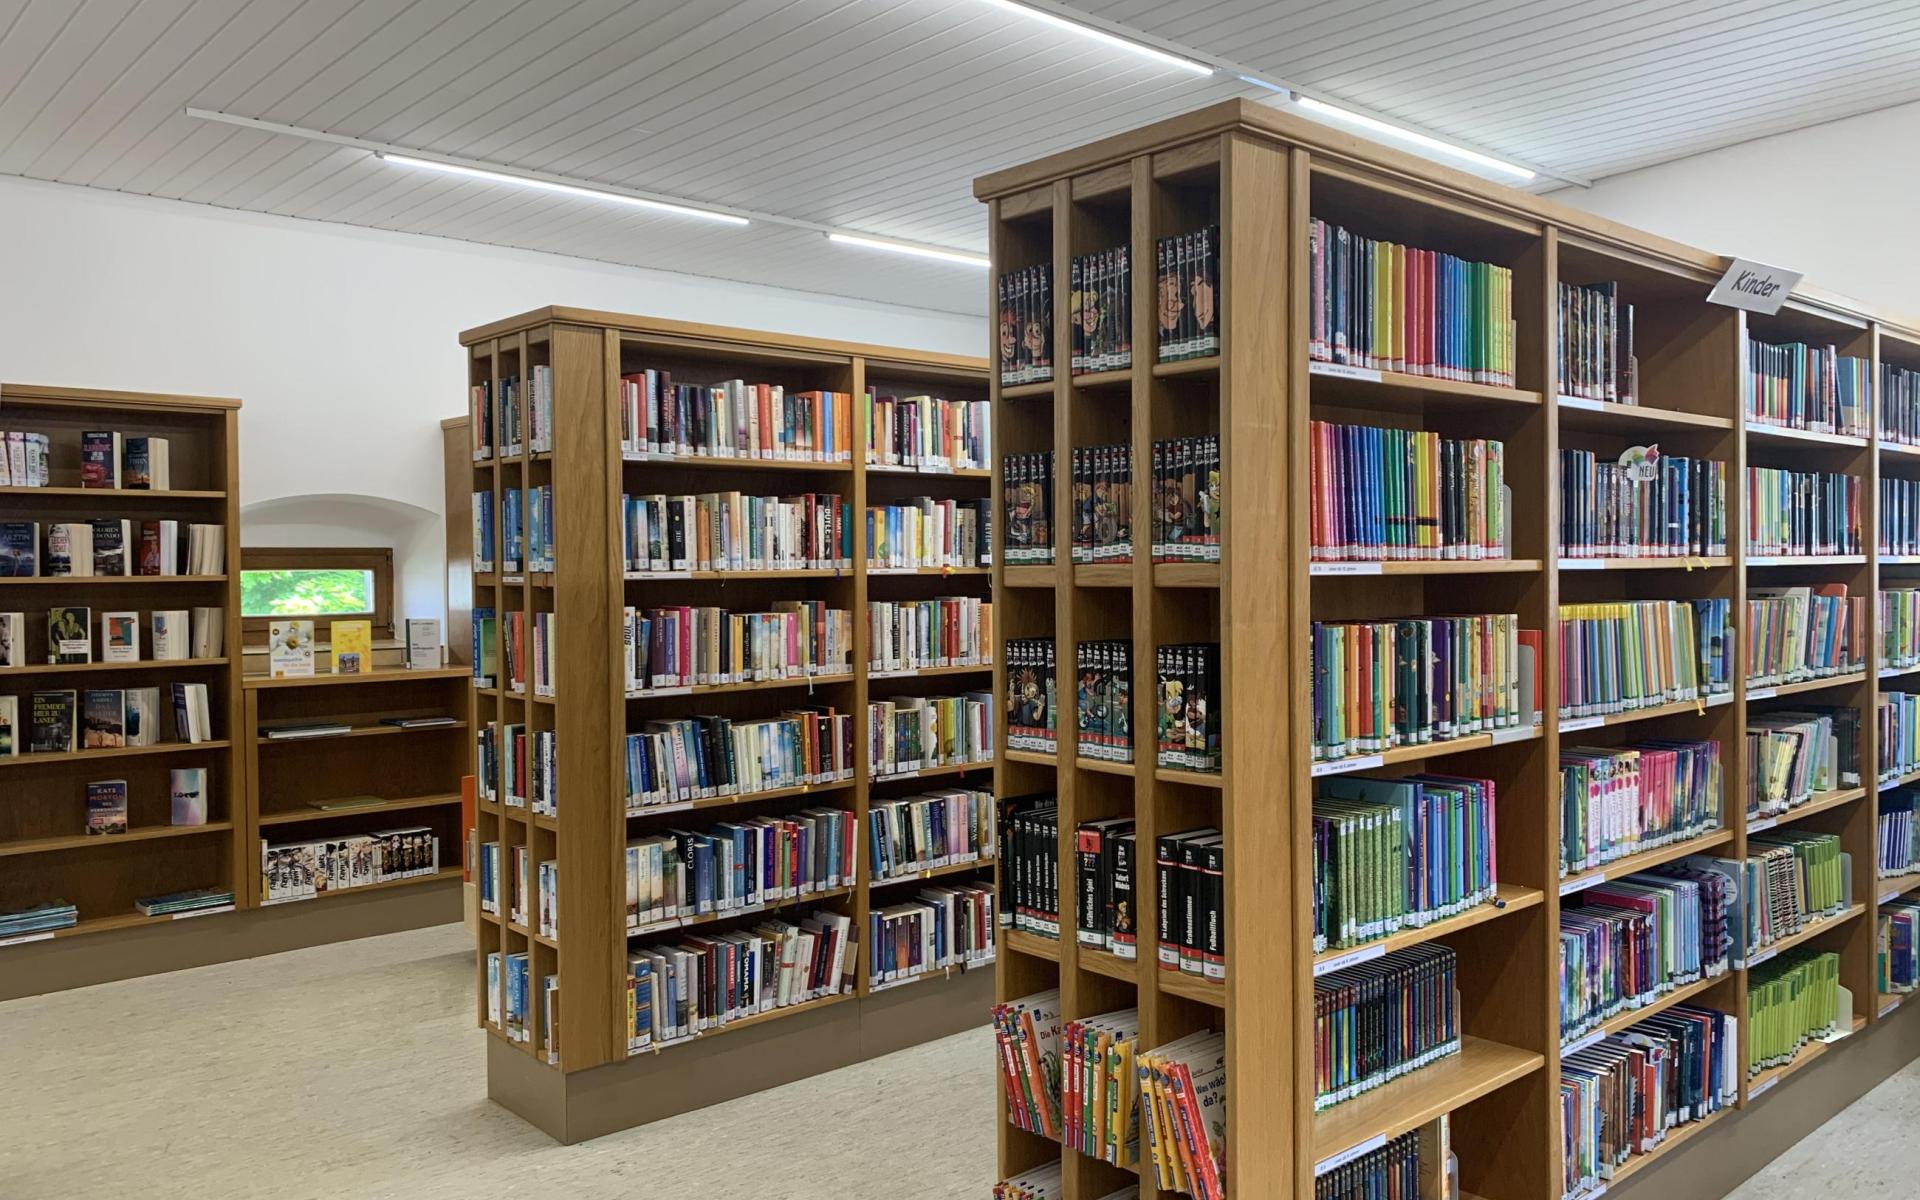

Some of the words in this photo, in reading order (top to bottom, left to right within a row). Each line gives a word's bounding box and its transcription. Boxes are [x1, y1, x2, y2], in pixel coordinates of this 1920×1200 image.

[1731, 270, 1780, 298] Kinder
[1639, 466, 1656, 478] NEU
[624, 624, 632, 646] SOUL
[1086, 878, 1095, 893] Spiel
[1086, 894, 1094, 928] Gefährliches
[1040, 1031, 1051, 1040] Die
[1196, 1085, 1209, 1095] Was
[1203, 1092, 1218, 1108] da?
